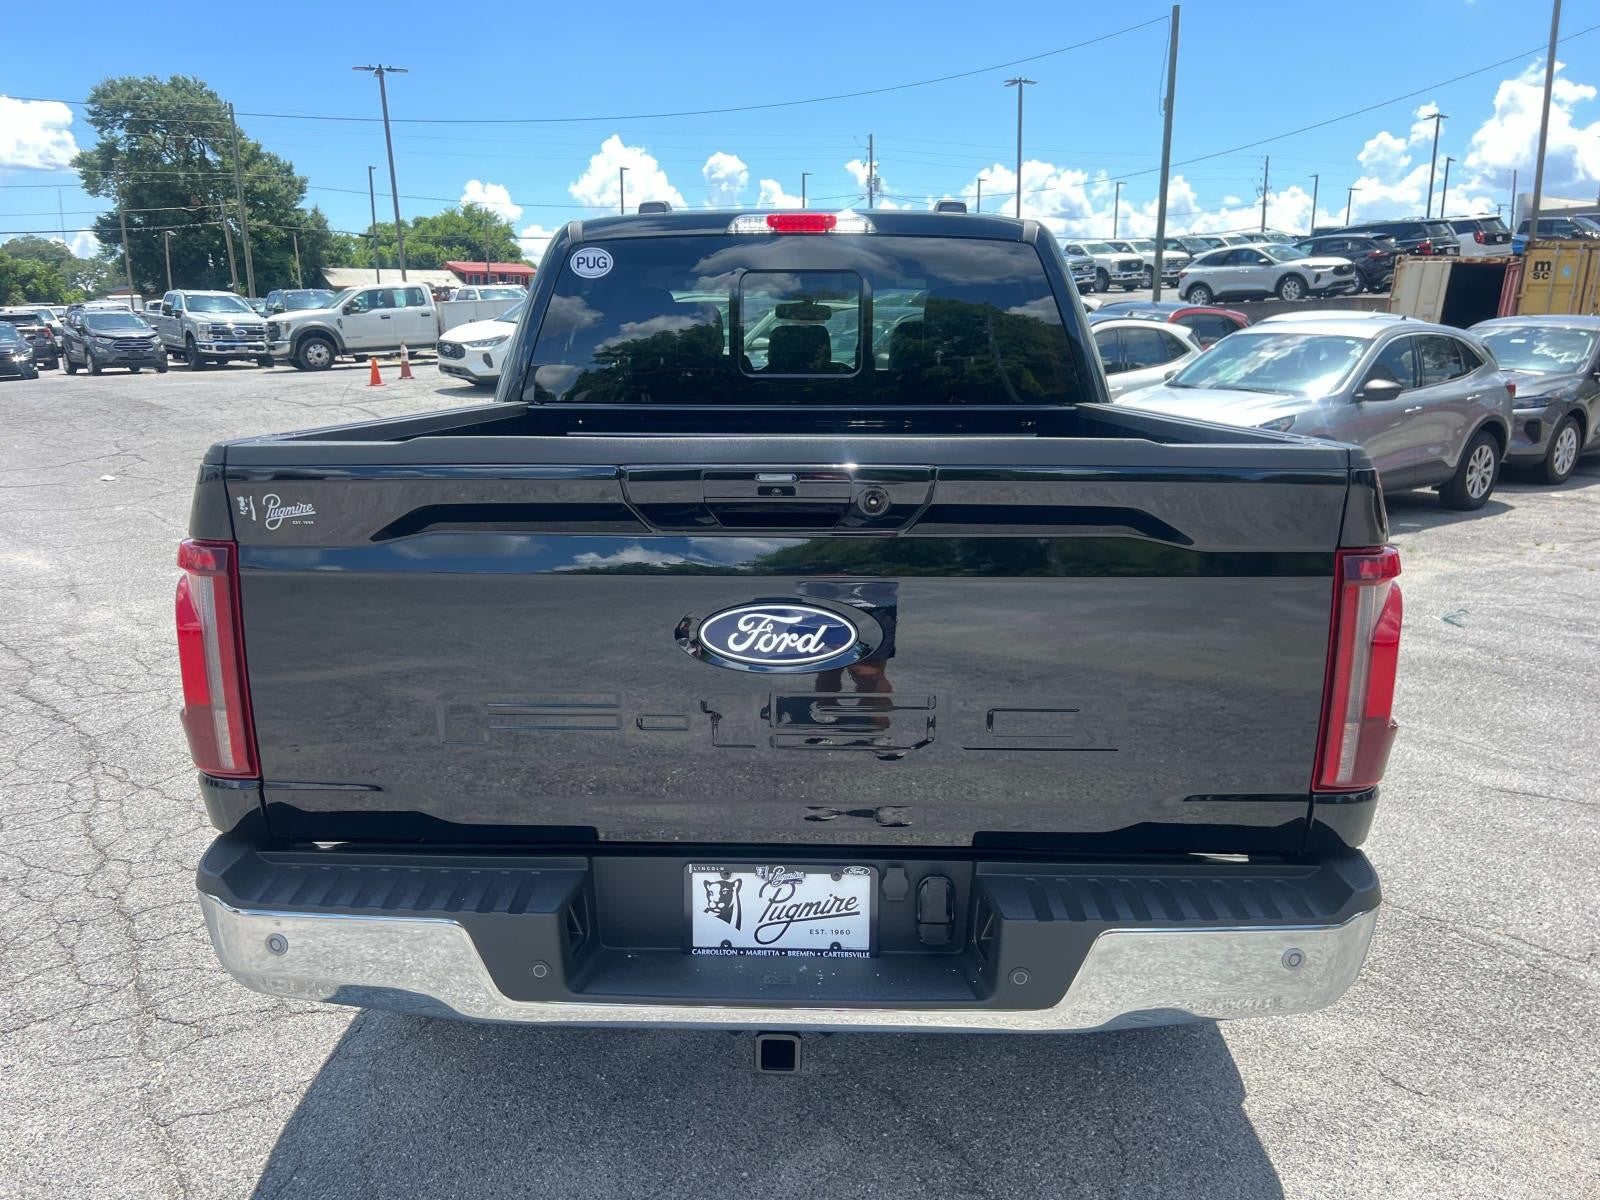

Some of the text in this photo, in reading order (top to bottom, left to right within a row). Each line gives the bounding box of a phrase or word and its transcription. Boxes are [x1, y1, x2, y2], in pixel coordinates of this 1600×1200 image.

[576, 256, 608, 269] PUG
[262, 493, 316, 530] Pugmire
[727, 613, 828, 653] Ford
[754, 881, 860, 945] Pugmire
[692, 948, 738, 956] CARROLLTON
[745, 949, 780, 957] MARIETTA
[822, 951, 871, 959] CARTERSVILLE
